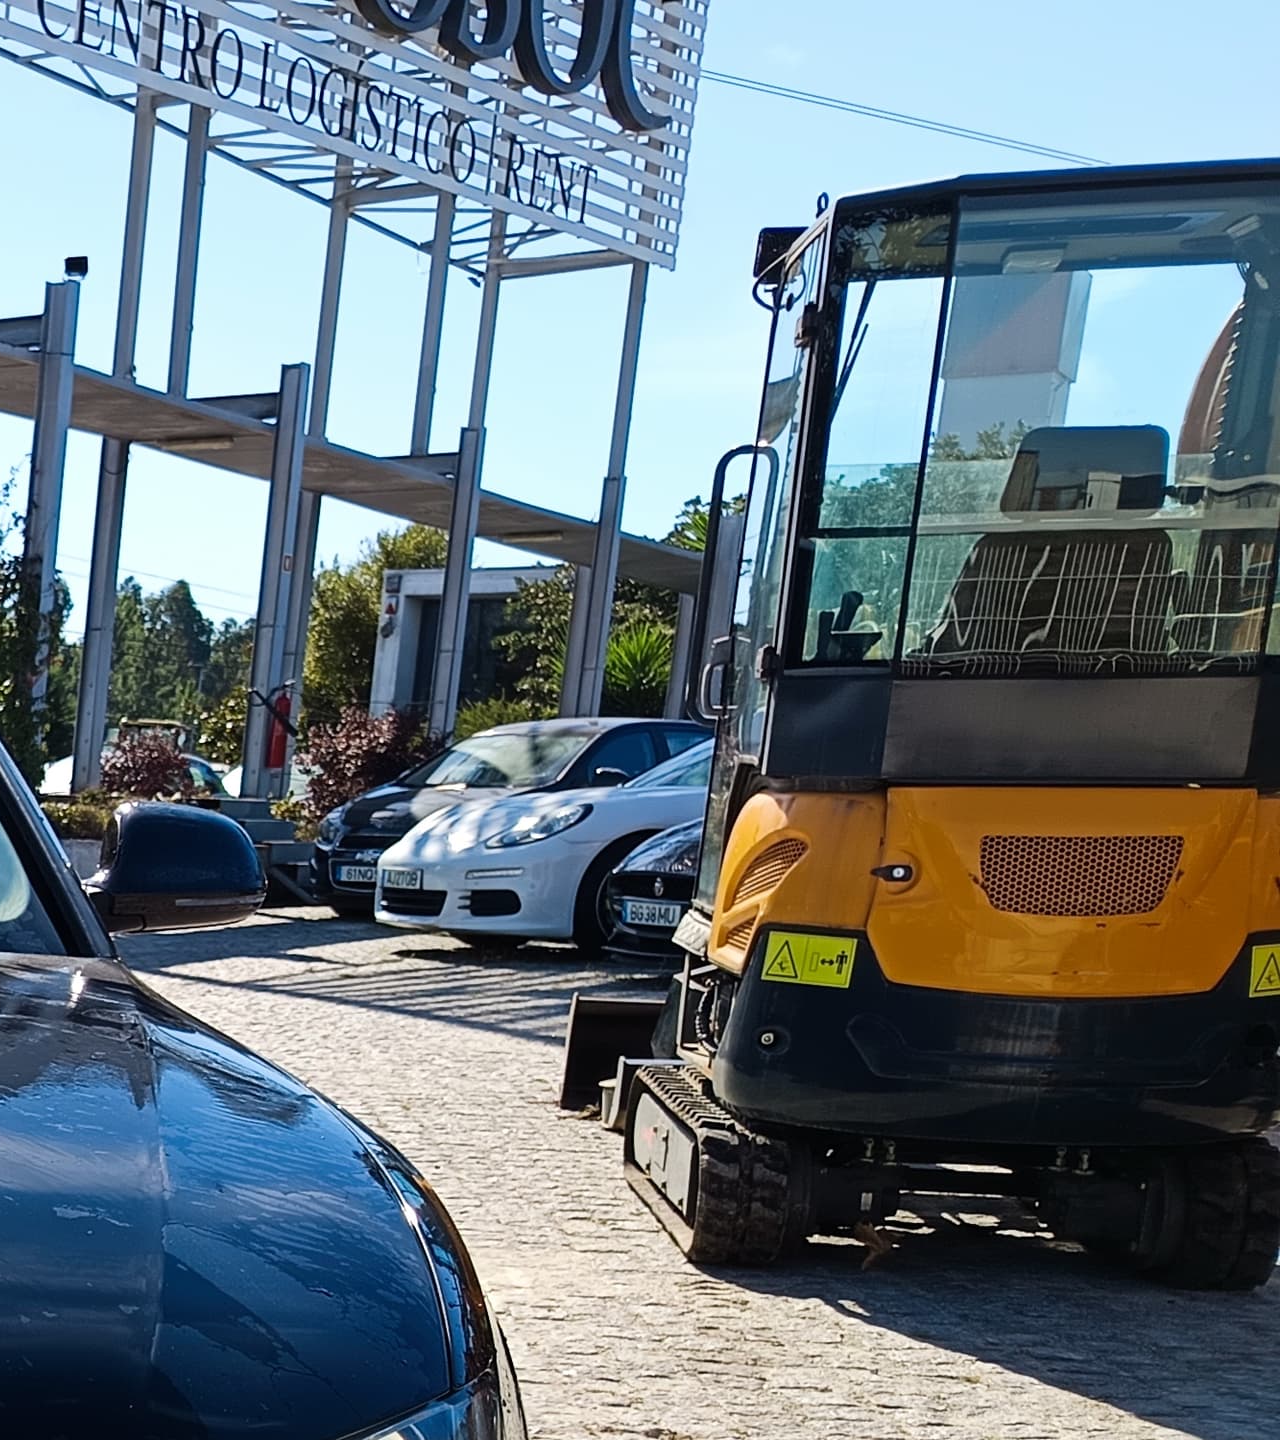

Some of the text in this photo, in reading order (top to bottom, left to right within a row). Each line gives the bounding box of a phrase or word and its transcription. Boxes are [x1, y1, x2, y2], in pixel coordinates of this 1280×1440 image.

[39, 0, 243, 99] CENTRO
[255, 41, 476, 183] LOGÍSTICO
[504, 134, 598, 224] RENT
